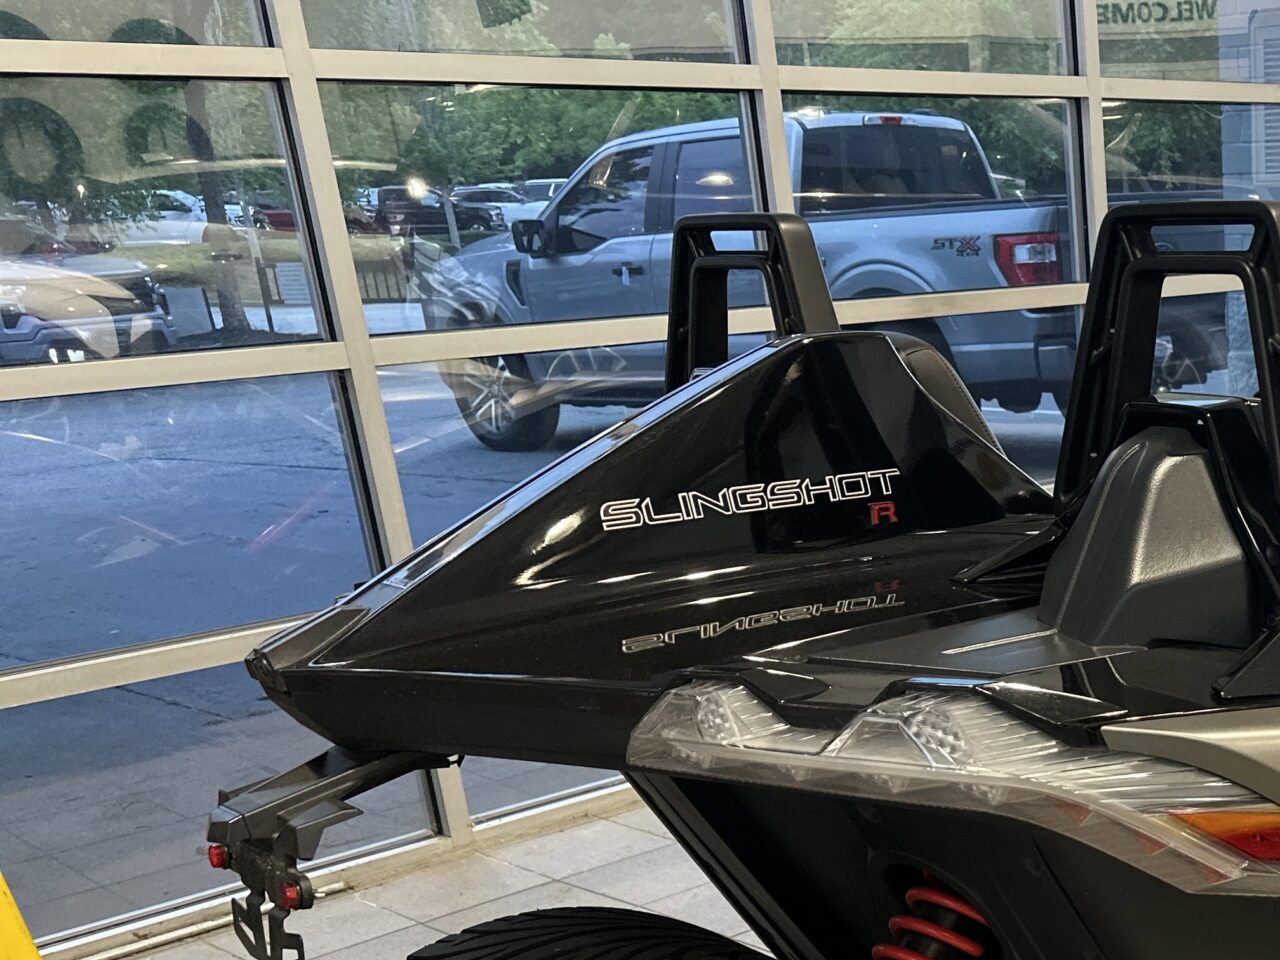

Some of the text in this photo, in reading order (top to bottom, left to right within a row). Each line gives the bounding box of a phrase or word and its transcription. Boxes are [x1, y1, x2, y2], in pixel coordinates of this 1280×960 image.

[930, 235, 981, 252] STX
[600, 468, 900, 531] SLINGSHOT
[868, 501, 898, 525] R
